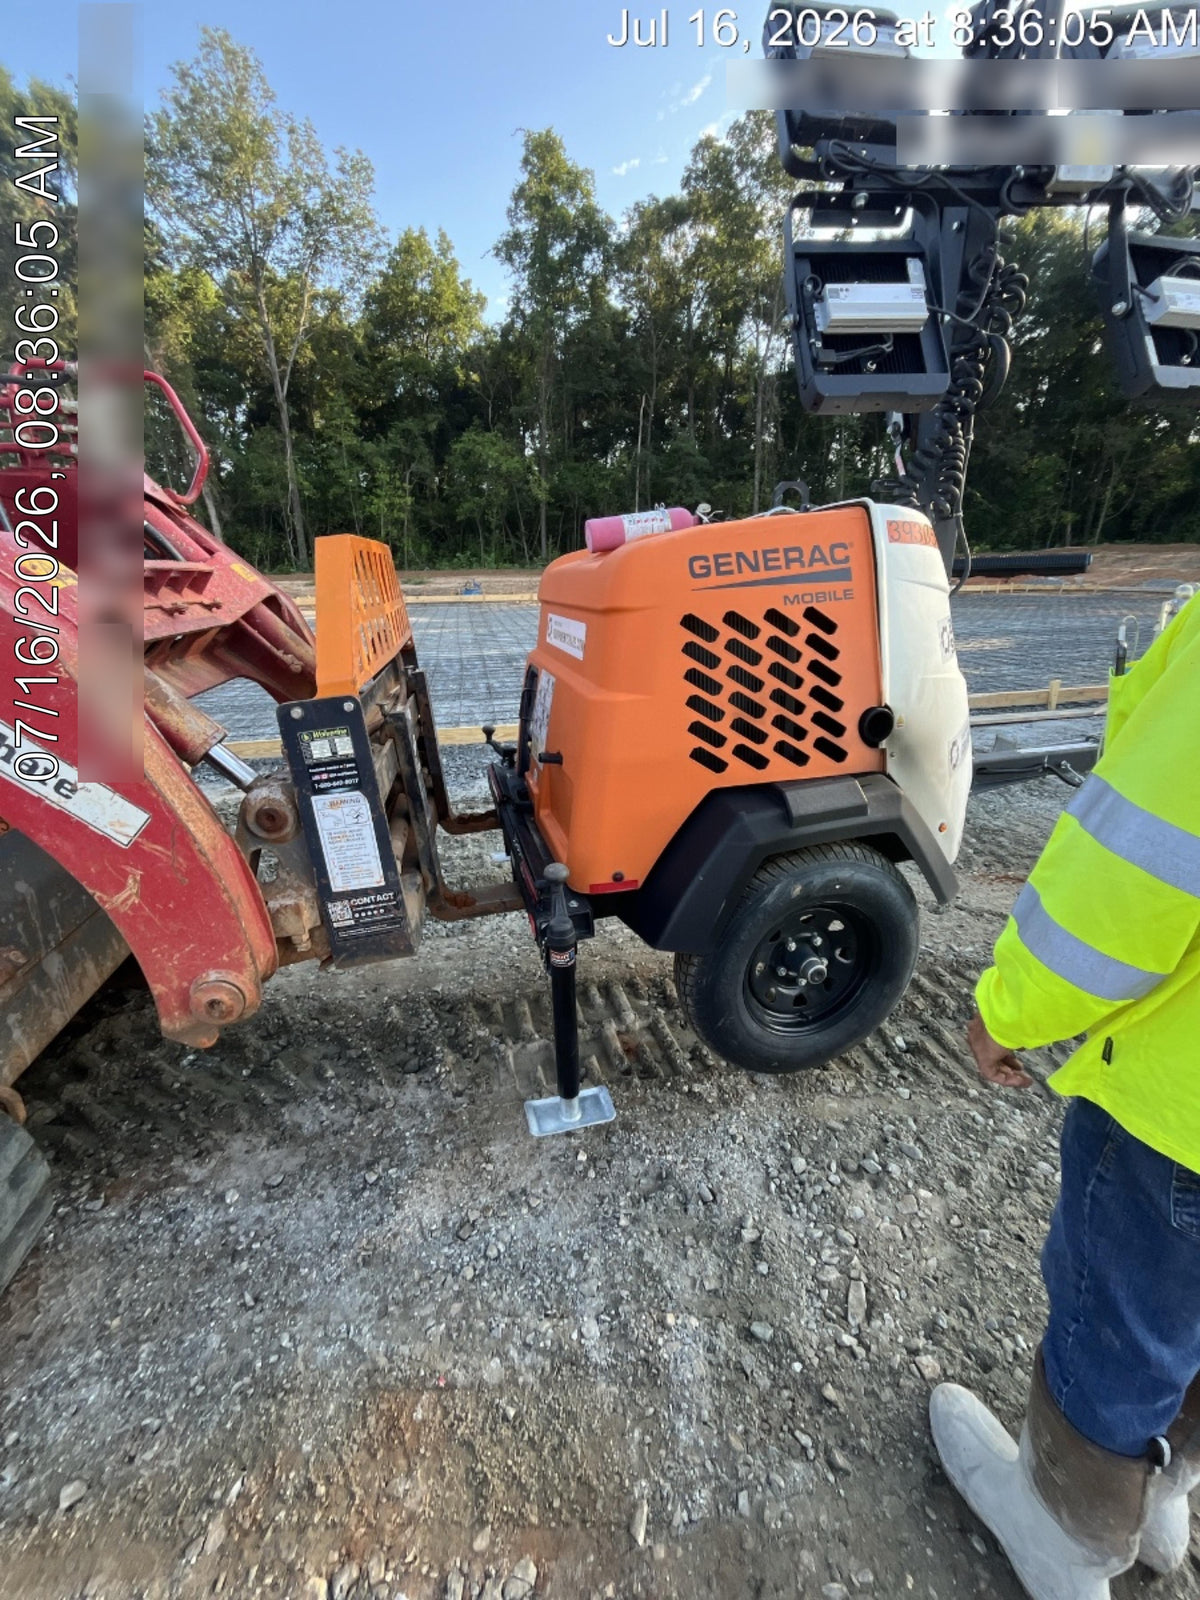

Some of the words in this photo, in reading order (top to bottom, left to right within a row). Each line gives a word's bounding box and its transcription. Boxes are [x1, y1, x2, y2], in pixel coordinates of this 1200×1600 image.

[688, 542, 851, 580] GENERAC
[783, 588, 855, 606] MOBILE
[350, 891, 395, 906] CONTACT
